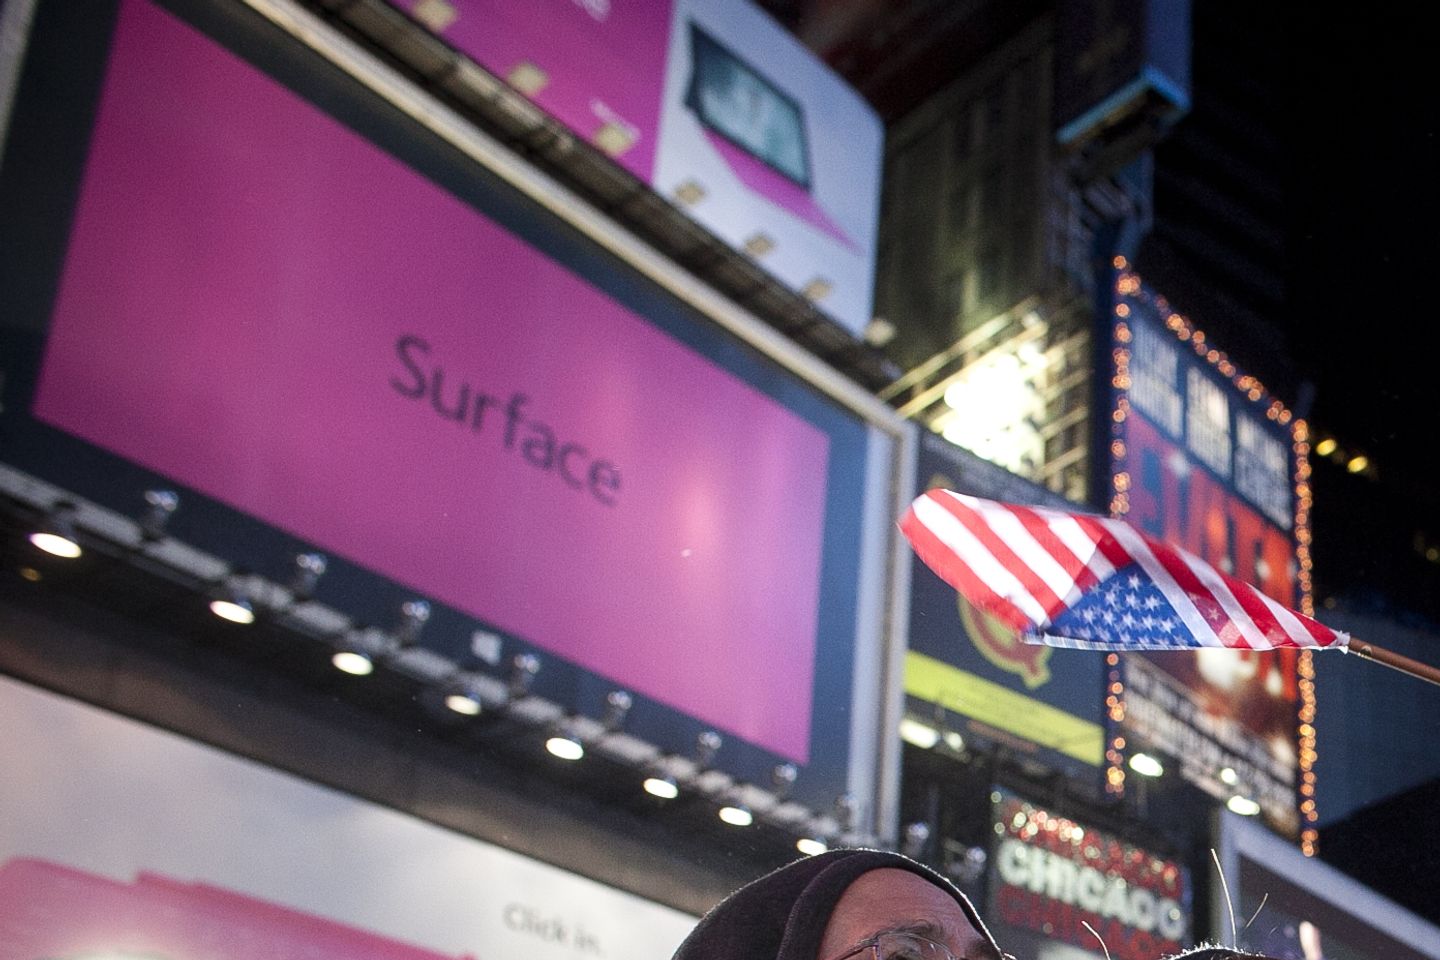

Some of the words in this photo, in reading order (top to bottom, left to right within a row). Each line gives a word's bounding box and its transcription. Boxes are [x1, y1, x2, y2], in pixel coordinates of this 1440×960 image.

[389, 333, 621, 506] Surface
[502, 901, 568, 946] Click
[999, 838, 1187, 941] CHICAGO
